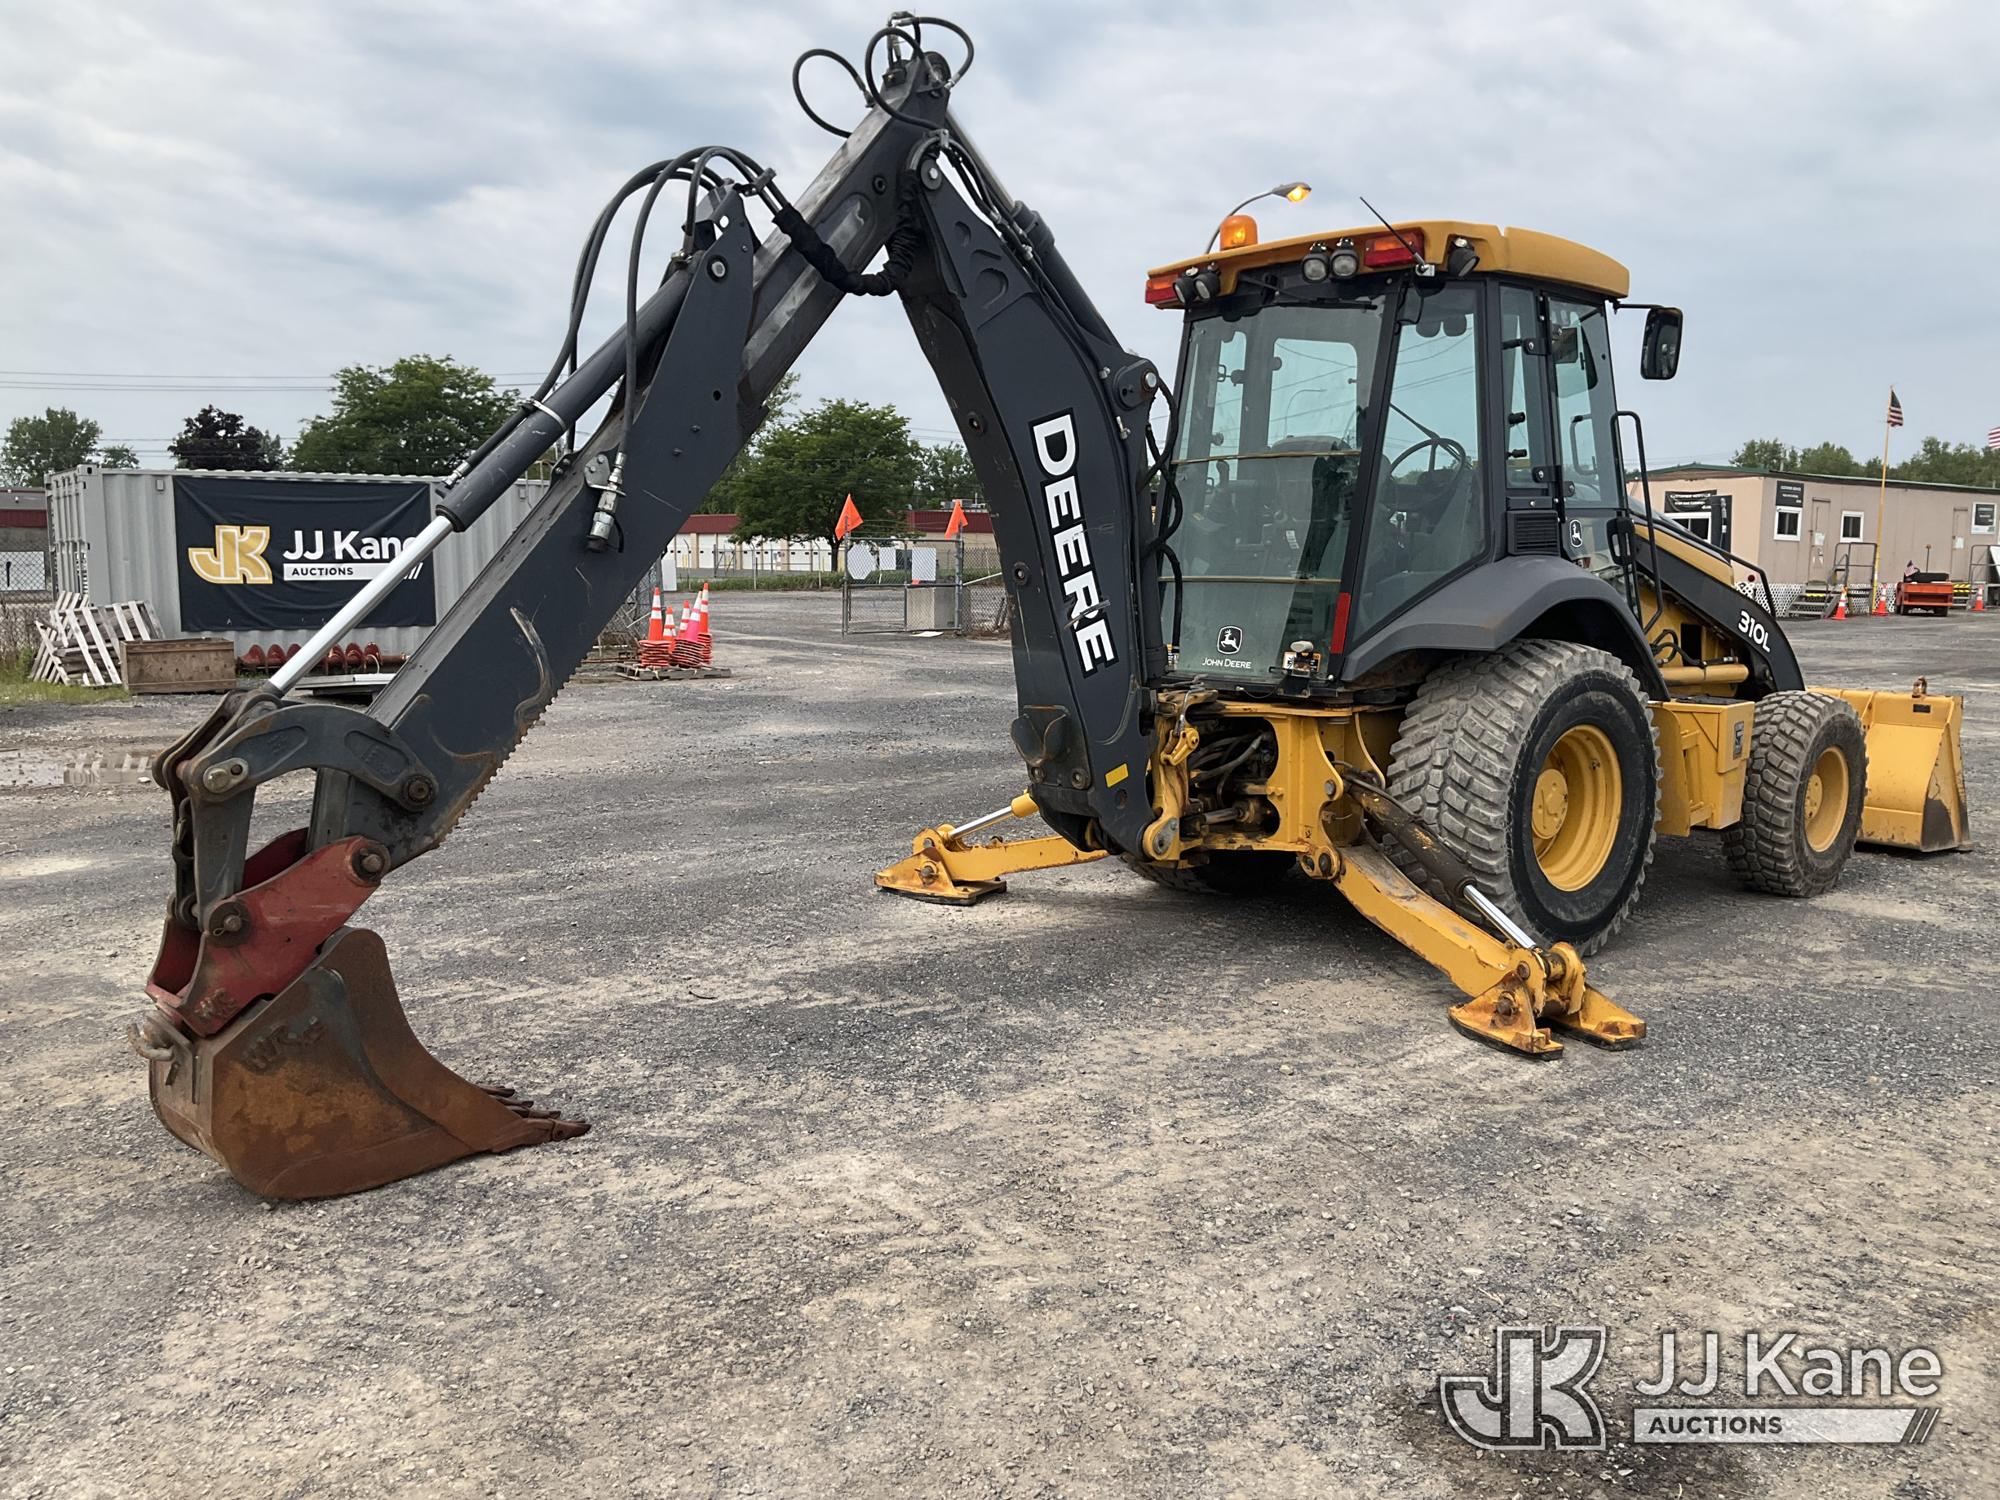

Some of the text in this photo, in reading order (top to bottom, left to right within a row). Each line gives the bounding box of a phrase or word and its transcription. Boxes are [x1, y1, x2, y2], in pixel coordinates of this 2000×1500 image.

[188, 524, 273, 584] JK
[282, 529, 325, 560] JJ
[1032, 413, 1115, 673] DEERE
[291, 567, 354, 576] AUCTIONS
[1738, 610, 1771, 653] 310L
[1202, 657, 1252, 669] JOHN DEERE
